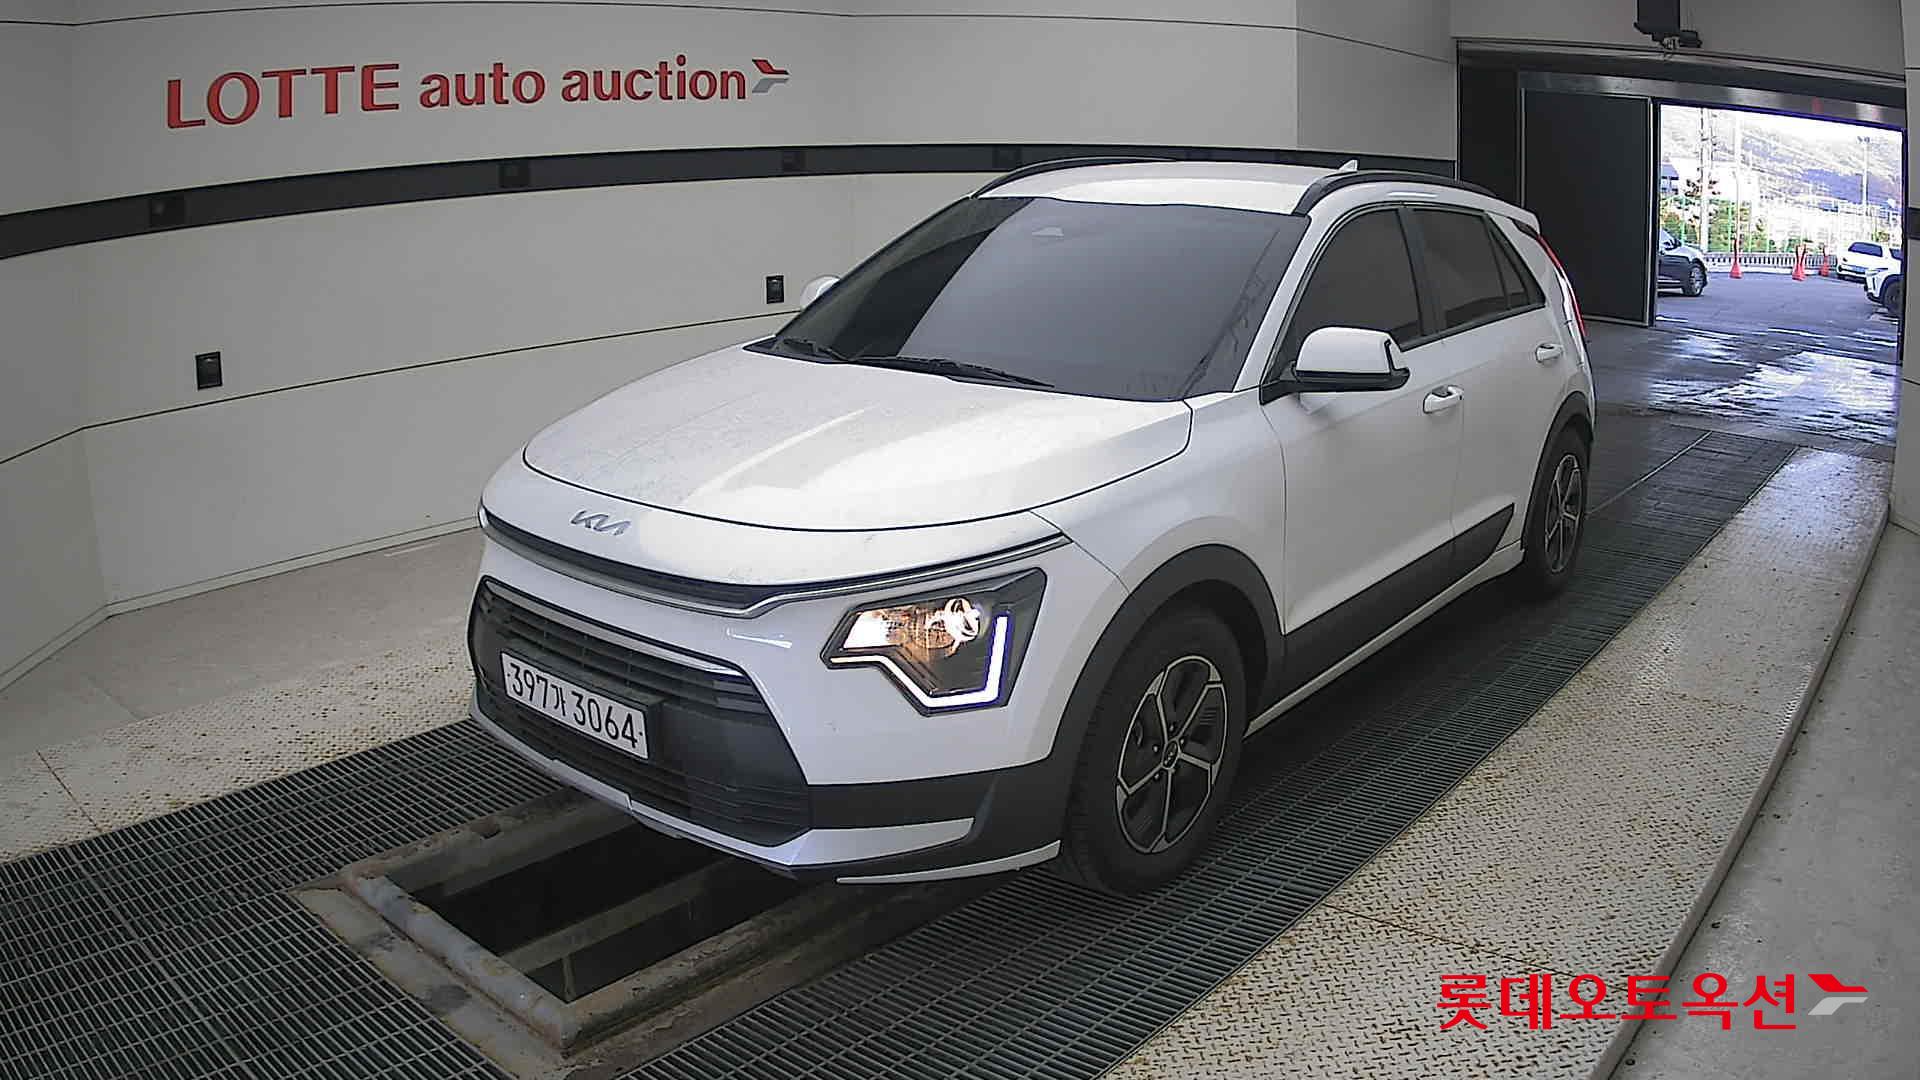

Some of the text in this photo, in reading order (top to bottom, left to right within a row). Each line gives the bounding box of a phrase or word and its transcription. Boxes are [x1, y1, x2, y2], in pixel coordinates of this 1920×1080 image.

[167, 54, 747, 130] LOTTE auto auction
[571, 690, 638, 749] 3064
